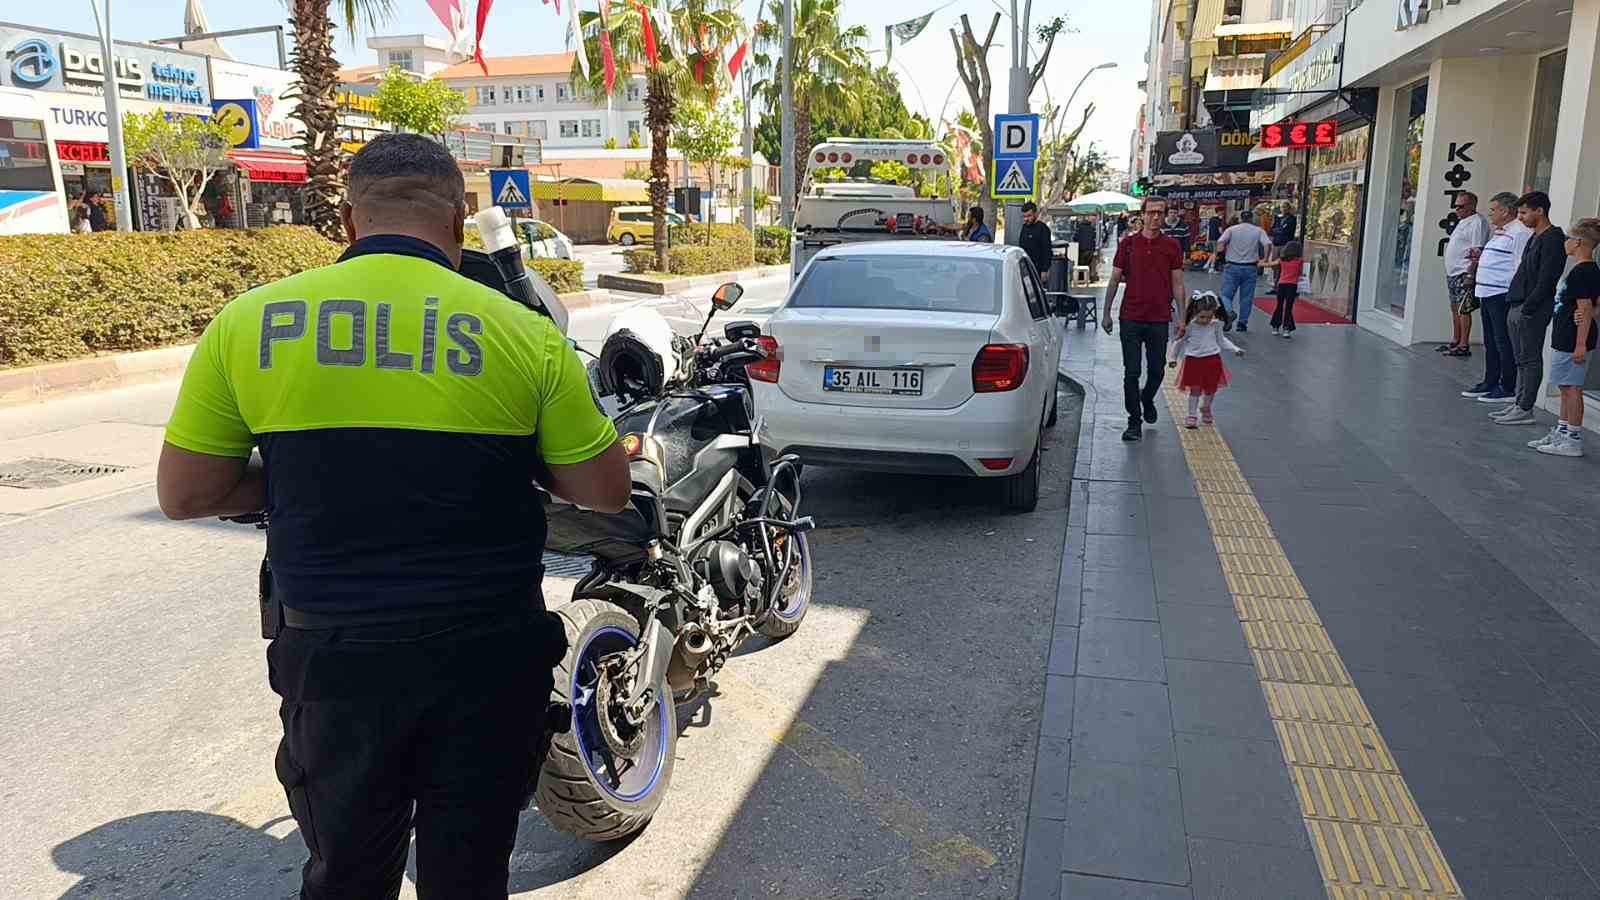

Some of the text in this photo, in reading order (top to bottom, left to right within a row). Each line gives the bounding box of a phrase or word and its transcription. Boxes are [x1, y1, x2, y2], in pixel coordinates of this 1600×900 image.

[1007, 125, 1026, 149] D
[1265, 124, 1281, 149] $
[1290, 124, 1306, 145] €
[833, 371, 919, 388] 35 AIL 116
